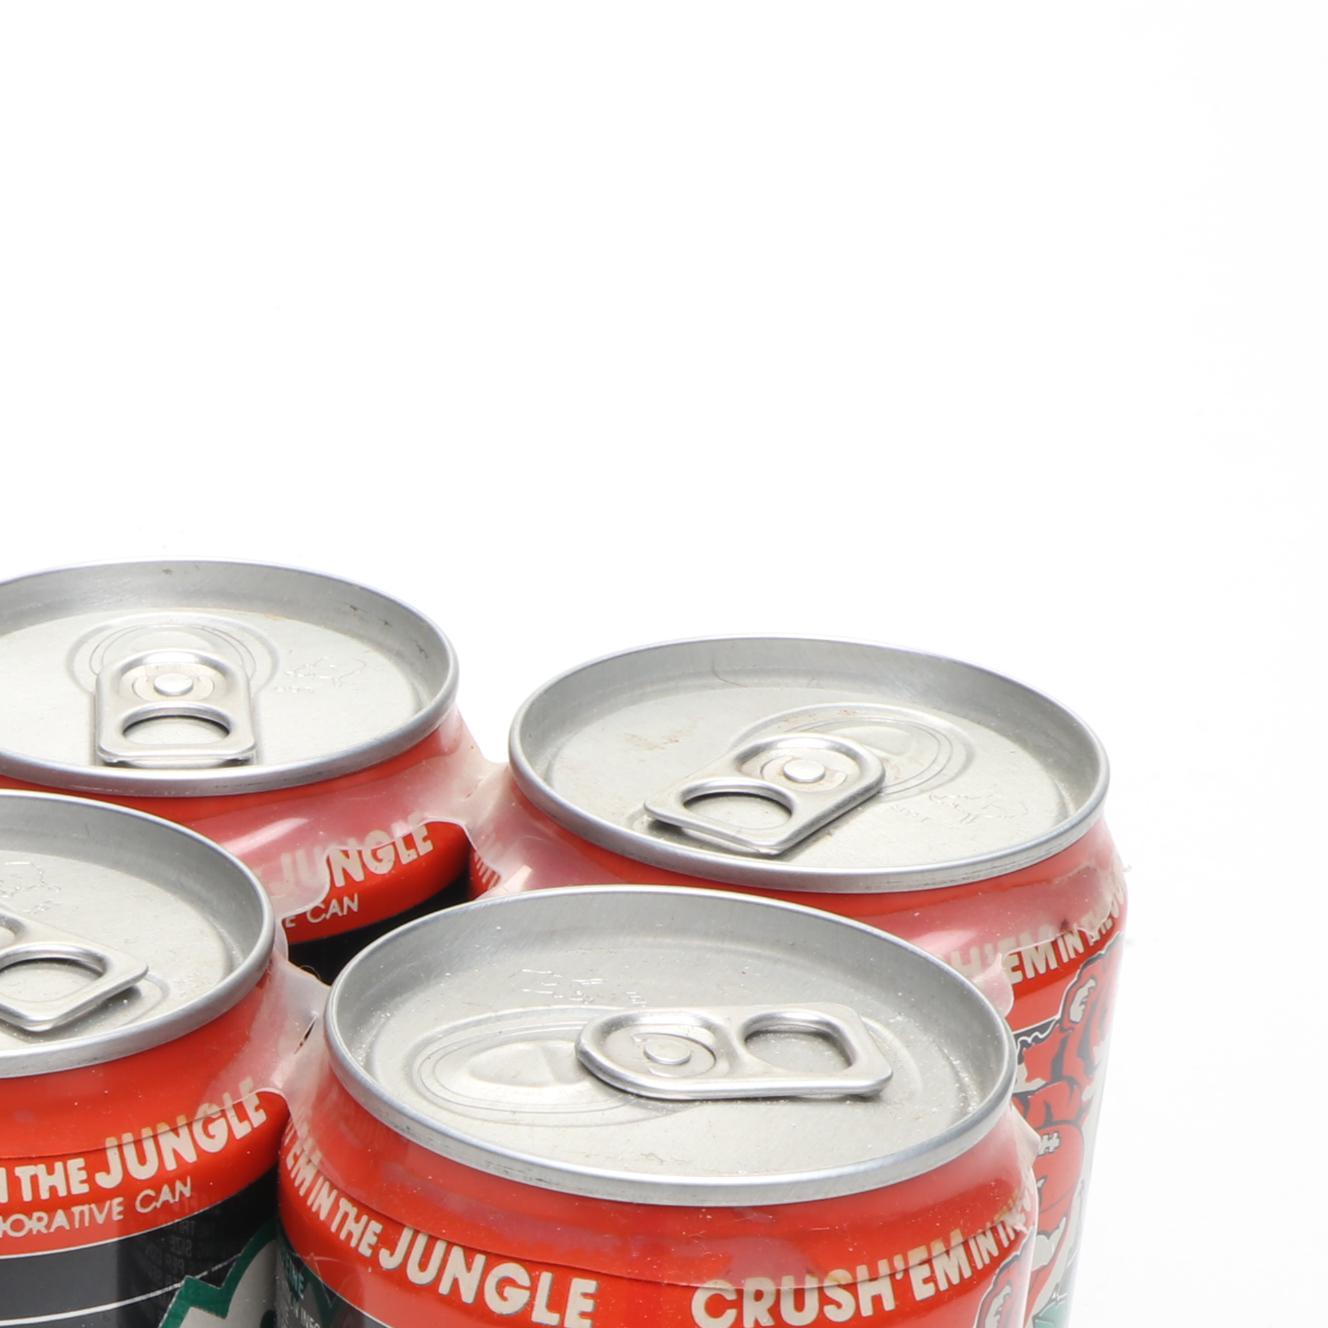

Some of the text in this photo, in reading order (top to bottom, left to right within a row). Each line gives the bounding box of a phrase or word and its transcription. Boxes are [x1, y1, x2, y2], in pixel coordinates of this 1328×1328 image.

[306, 893, 359, 924] CAN
[15, 1158, 90, 1202] THE
[94, 1078, 268, 1189] JUNGLE
[134, 1176, 194, 1215] CAN
[307, 1176, 337, 1221] IN
[331, 1197, 383, 1258] THE
[969, 1223, 999, 1271] IN
